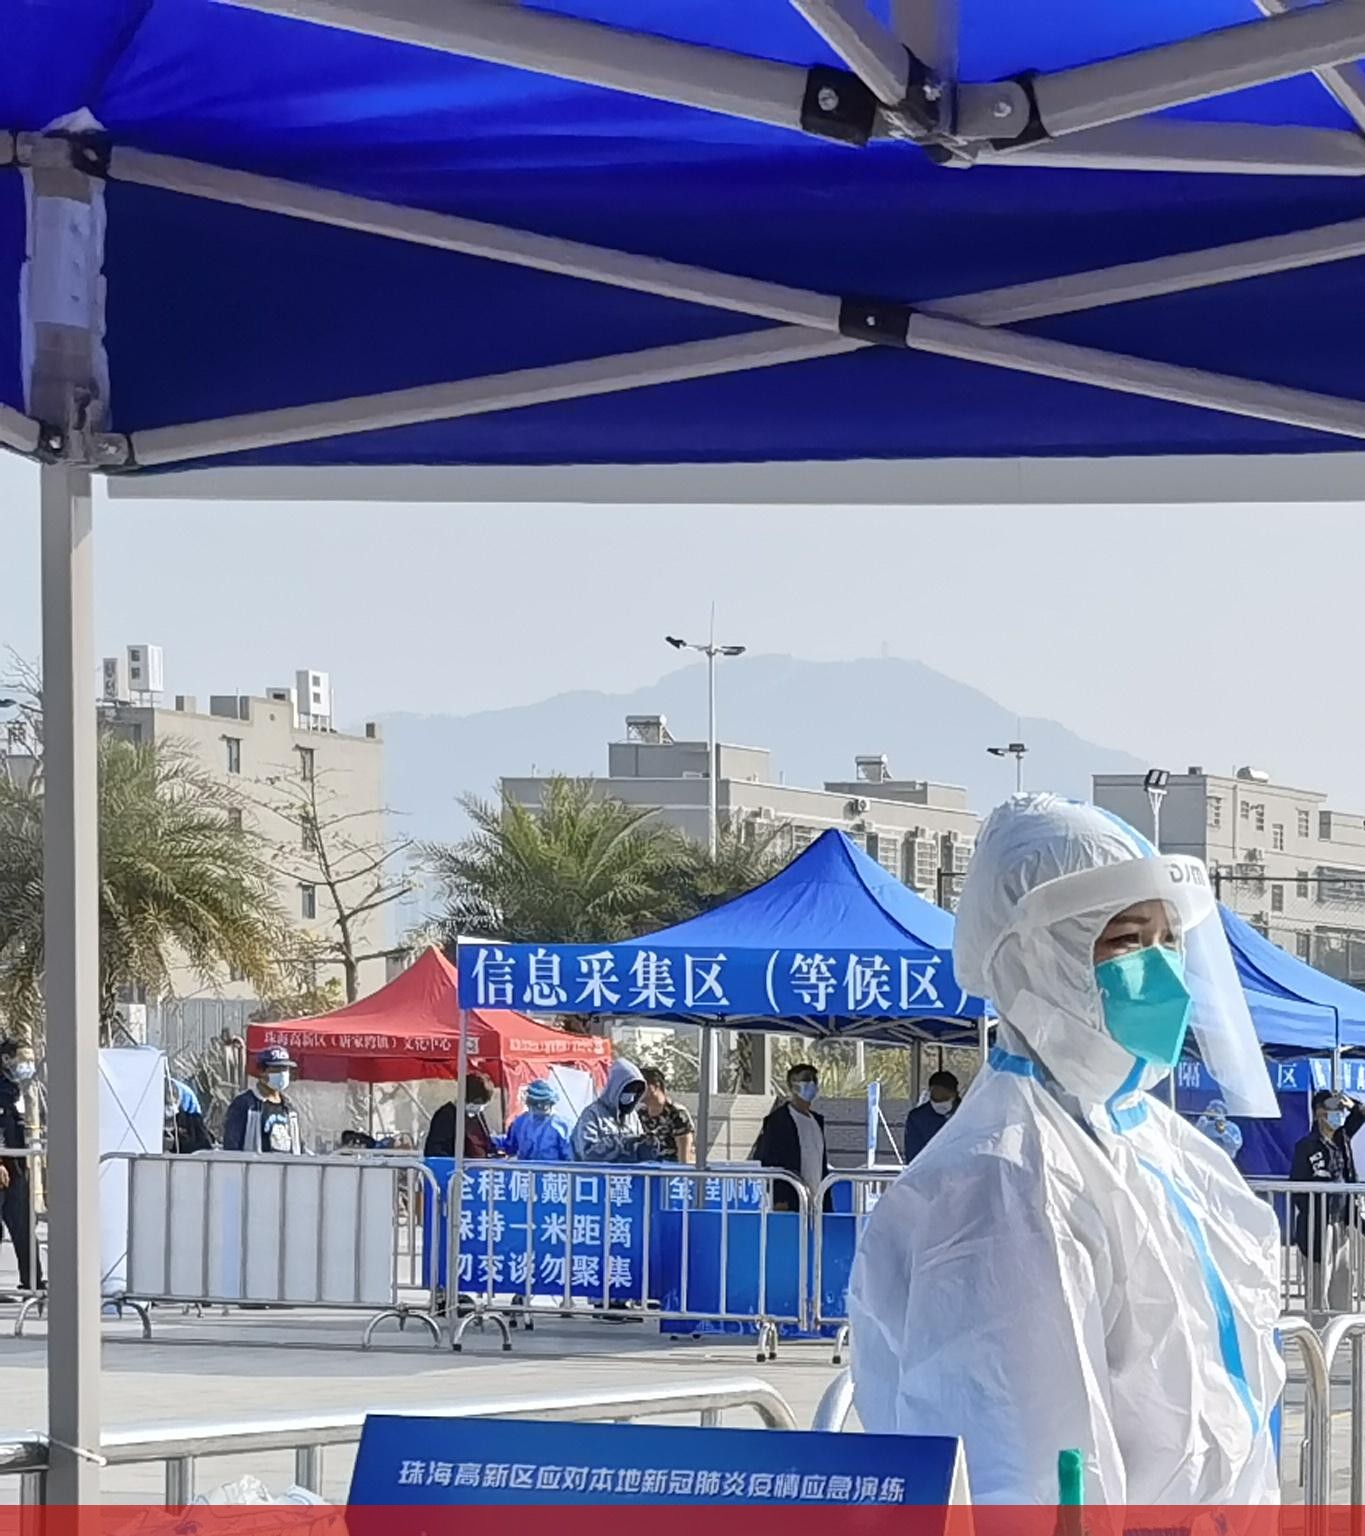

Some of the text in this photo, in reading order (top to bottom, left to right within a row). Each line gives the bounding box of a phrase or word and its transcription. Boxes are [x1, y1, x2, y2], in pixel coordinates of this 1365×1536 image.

[398, 1459, 905, 1503] 珠海高新区应对本地新冠肺炎疫情应急演练
